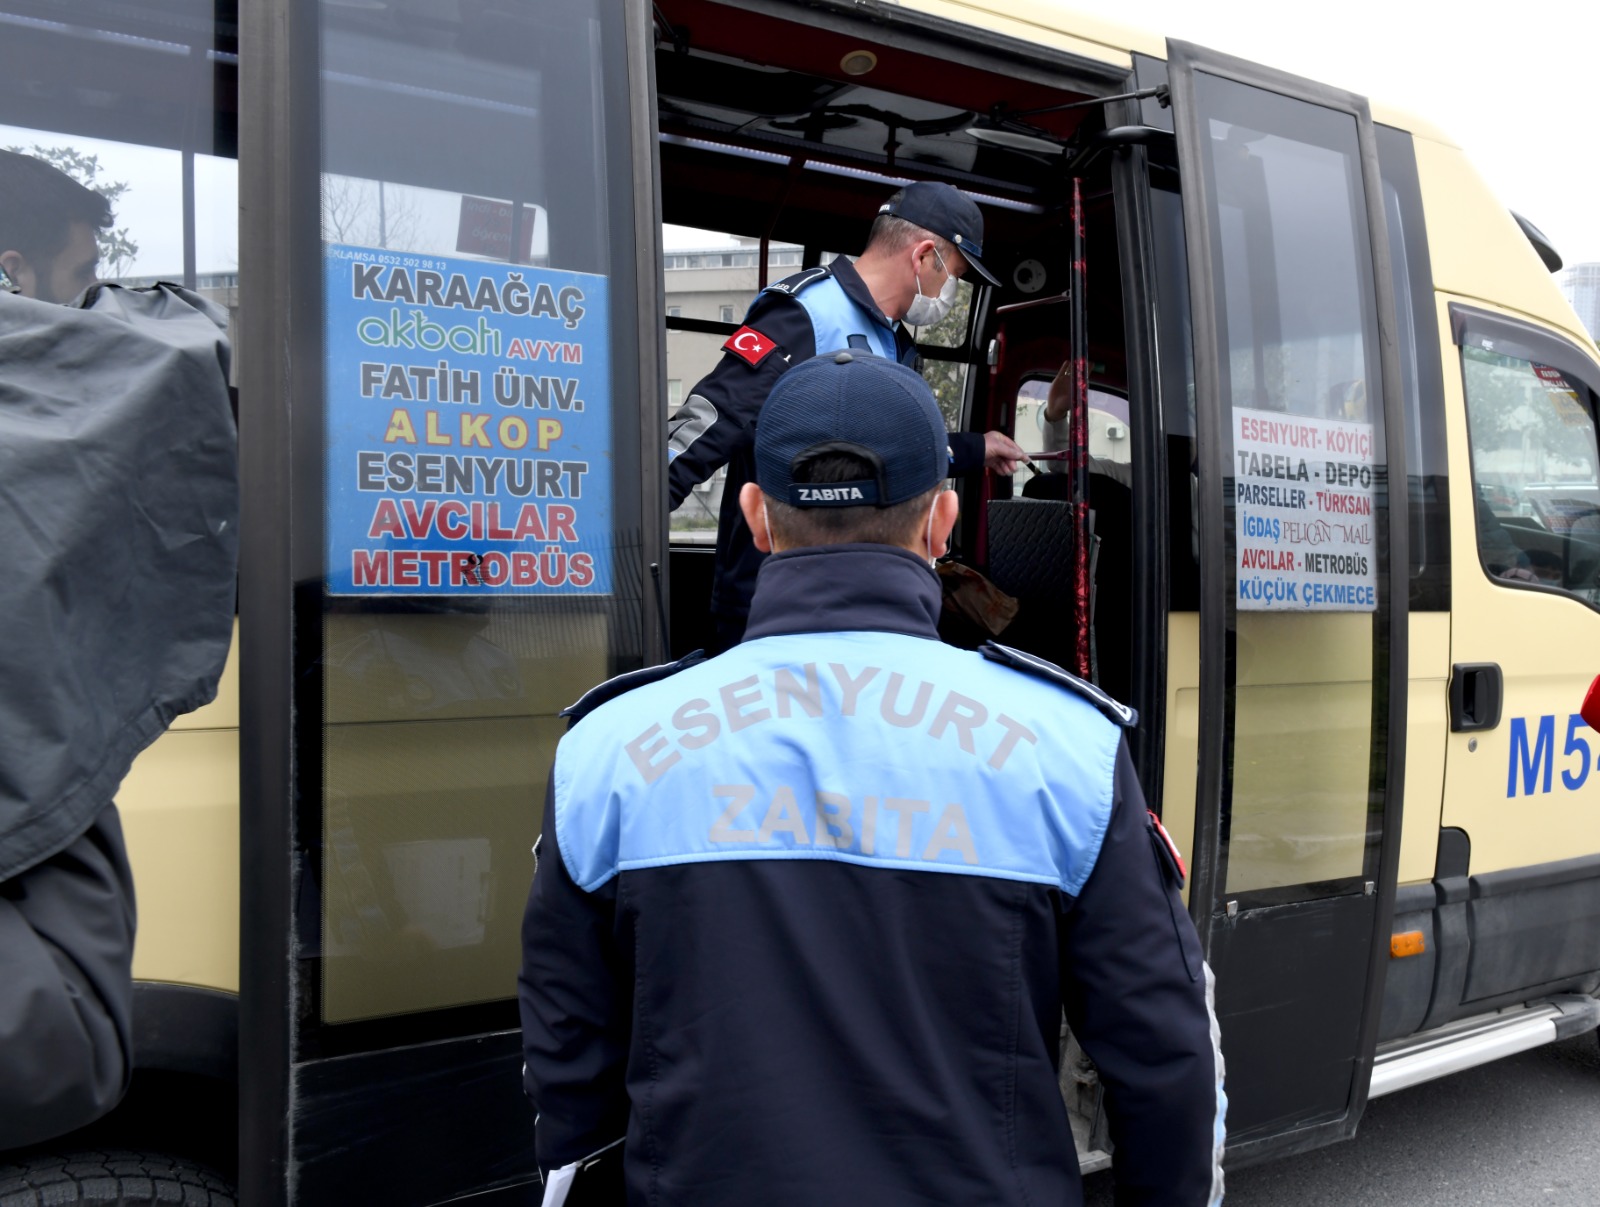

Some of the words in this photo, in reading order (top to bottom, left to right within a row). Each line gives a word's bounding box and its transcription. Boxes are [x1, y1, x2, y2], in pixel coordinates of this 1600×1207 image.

[378, 255, 400, 265] 0532
[402, 257, 420, 268] 502
[422, 260, 433, 269] 98
[436, 261, 447, 271] 13
[352, 262, 586, 329] KARAAĞAÇ
[357, 308, 502, 356] akbatı
[507, 338, 583, 364] AVYM
[360, 360, 481, 405] FATİH
[493, 367, 586, 413] ÜNV.
[383, 408, 564, 452] ALKOP
[1326, 426, 1374, 462] KÖYİÇİ
[357, 451, 589, 499] ESENYURT
[1238, 450, 1309, 482] TABELA
[1325, 461, 1372, 489] DEPO
[798, 487, 863, 501] ZABITA
[1237, 483, 1306, 510] PARSELLER
[1316, 490, 1370, 516] TÜRKSAN
[367, 498, 579, 543] AVCILAR
[1243, 511, 1280, 544] İGDAŞ
[352, 545, 596, 588] METROBÜS
[1241, 548, 1295, 571] AVCILAR
[1305, 552, 1368, 576] METROBÜS
[1239, 576, 1298, 605] KÜÇÜK
[1303, 583, 1375, 607] ÇEKMECE
[624, 662, 1038, 785] ESENYURT
[1507, 714, 1600, 798] M5
[709, 785, 979, 865] ZABITA
